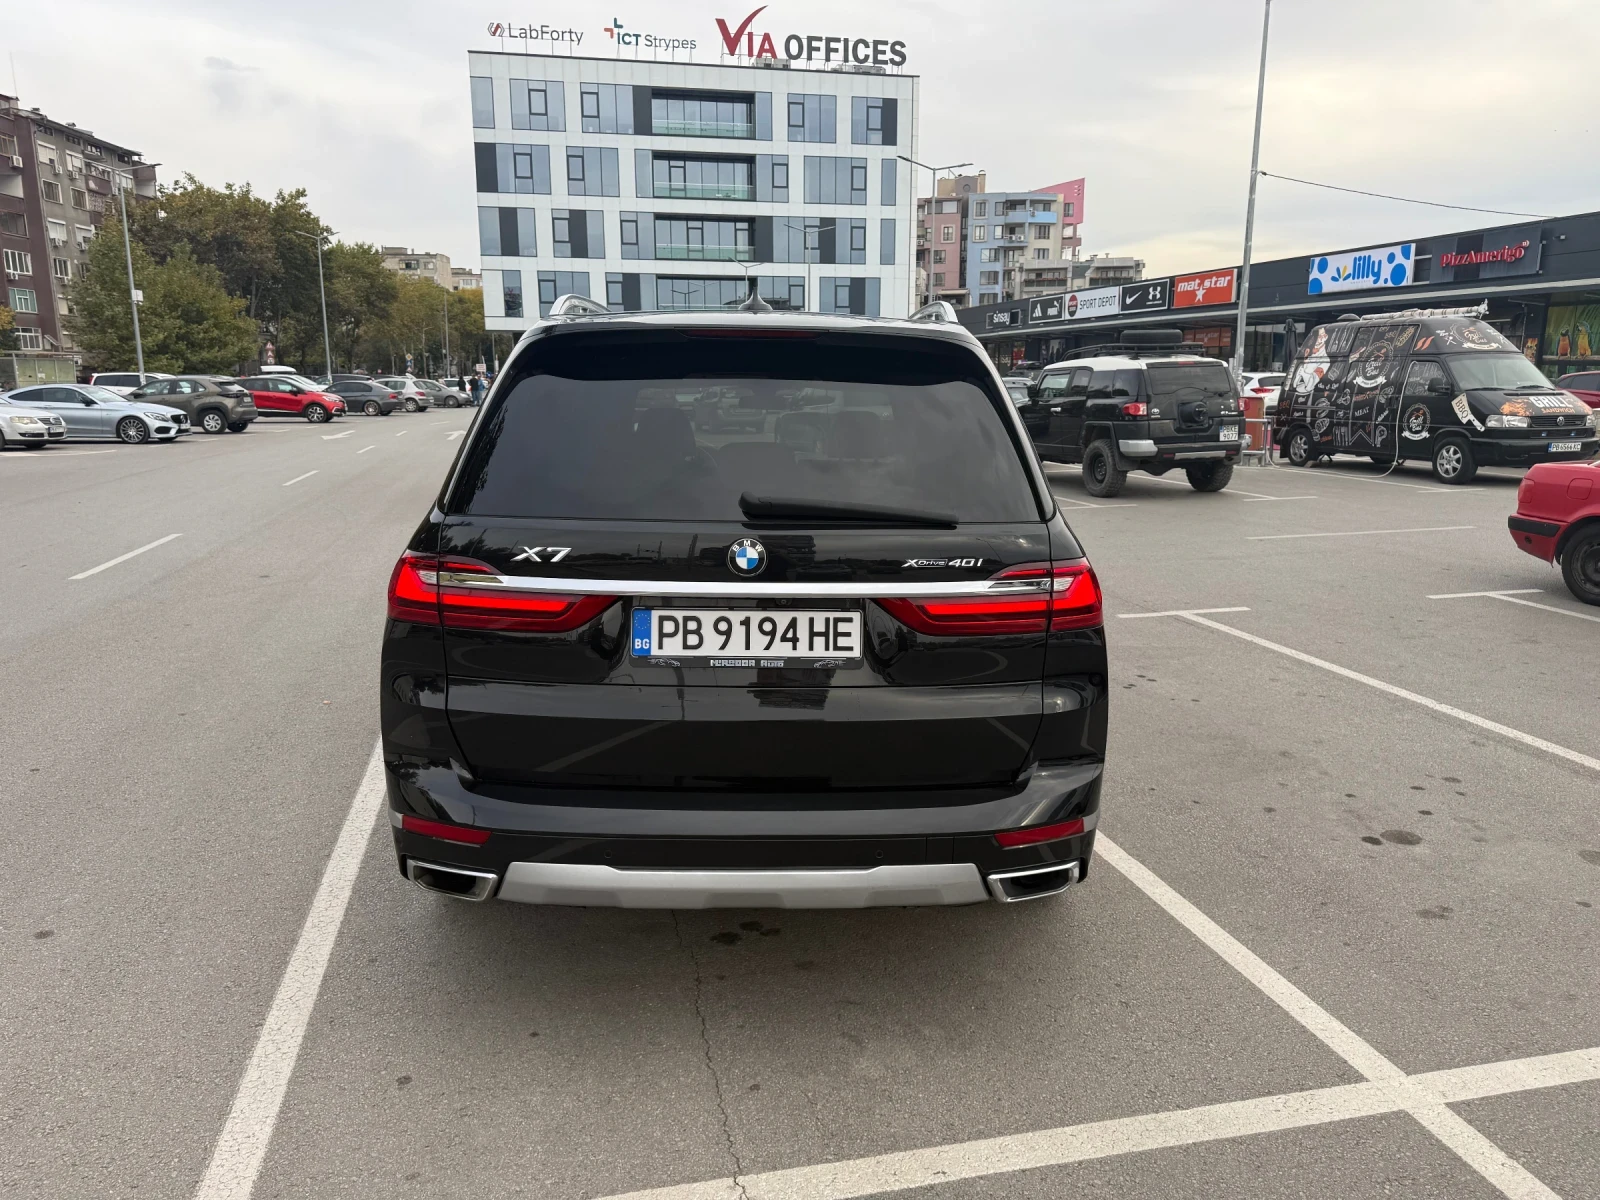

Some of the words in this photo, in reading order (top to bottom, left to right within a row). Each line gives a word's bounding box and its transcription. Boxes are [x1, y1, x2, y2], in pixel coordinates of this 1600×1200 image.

[508, 22, 584, 46] LabForty
[617, 32, 641, 46] ICT
[644, 34, 697, 51] Strypes
[715, 5, 778, 59] VIA
[784, 34, 907, 66] OFFICES
[1440, 241, 1526, 267] PizzAmerigo
[1351, 254, 1382, 285] lilly
[1177, 281, 1201, 292] mat
[1203, 276, 1231, 289] star
[1079, 299, 1097, 310] SPORT
[1097, 295, 1117, 307] DEPOT
[993, 310, 1011, 325] sinsay
[1455, 398, 1469, 420] BBQ
[1530, 395, 1573, 408] GRILL
[1354, 406, 1370, 417] MEAT
[1223, 432, 1238, 440] 9077
[732, 539, 763, 552] BMW
[510, 546, 572, 562] X7
[657, 615, 704, 650] PB
[713, 615, 800, 651] 9194
[808, 616, 854, 652] HE
[634, 638, 650, 649] BG
